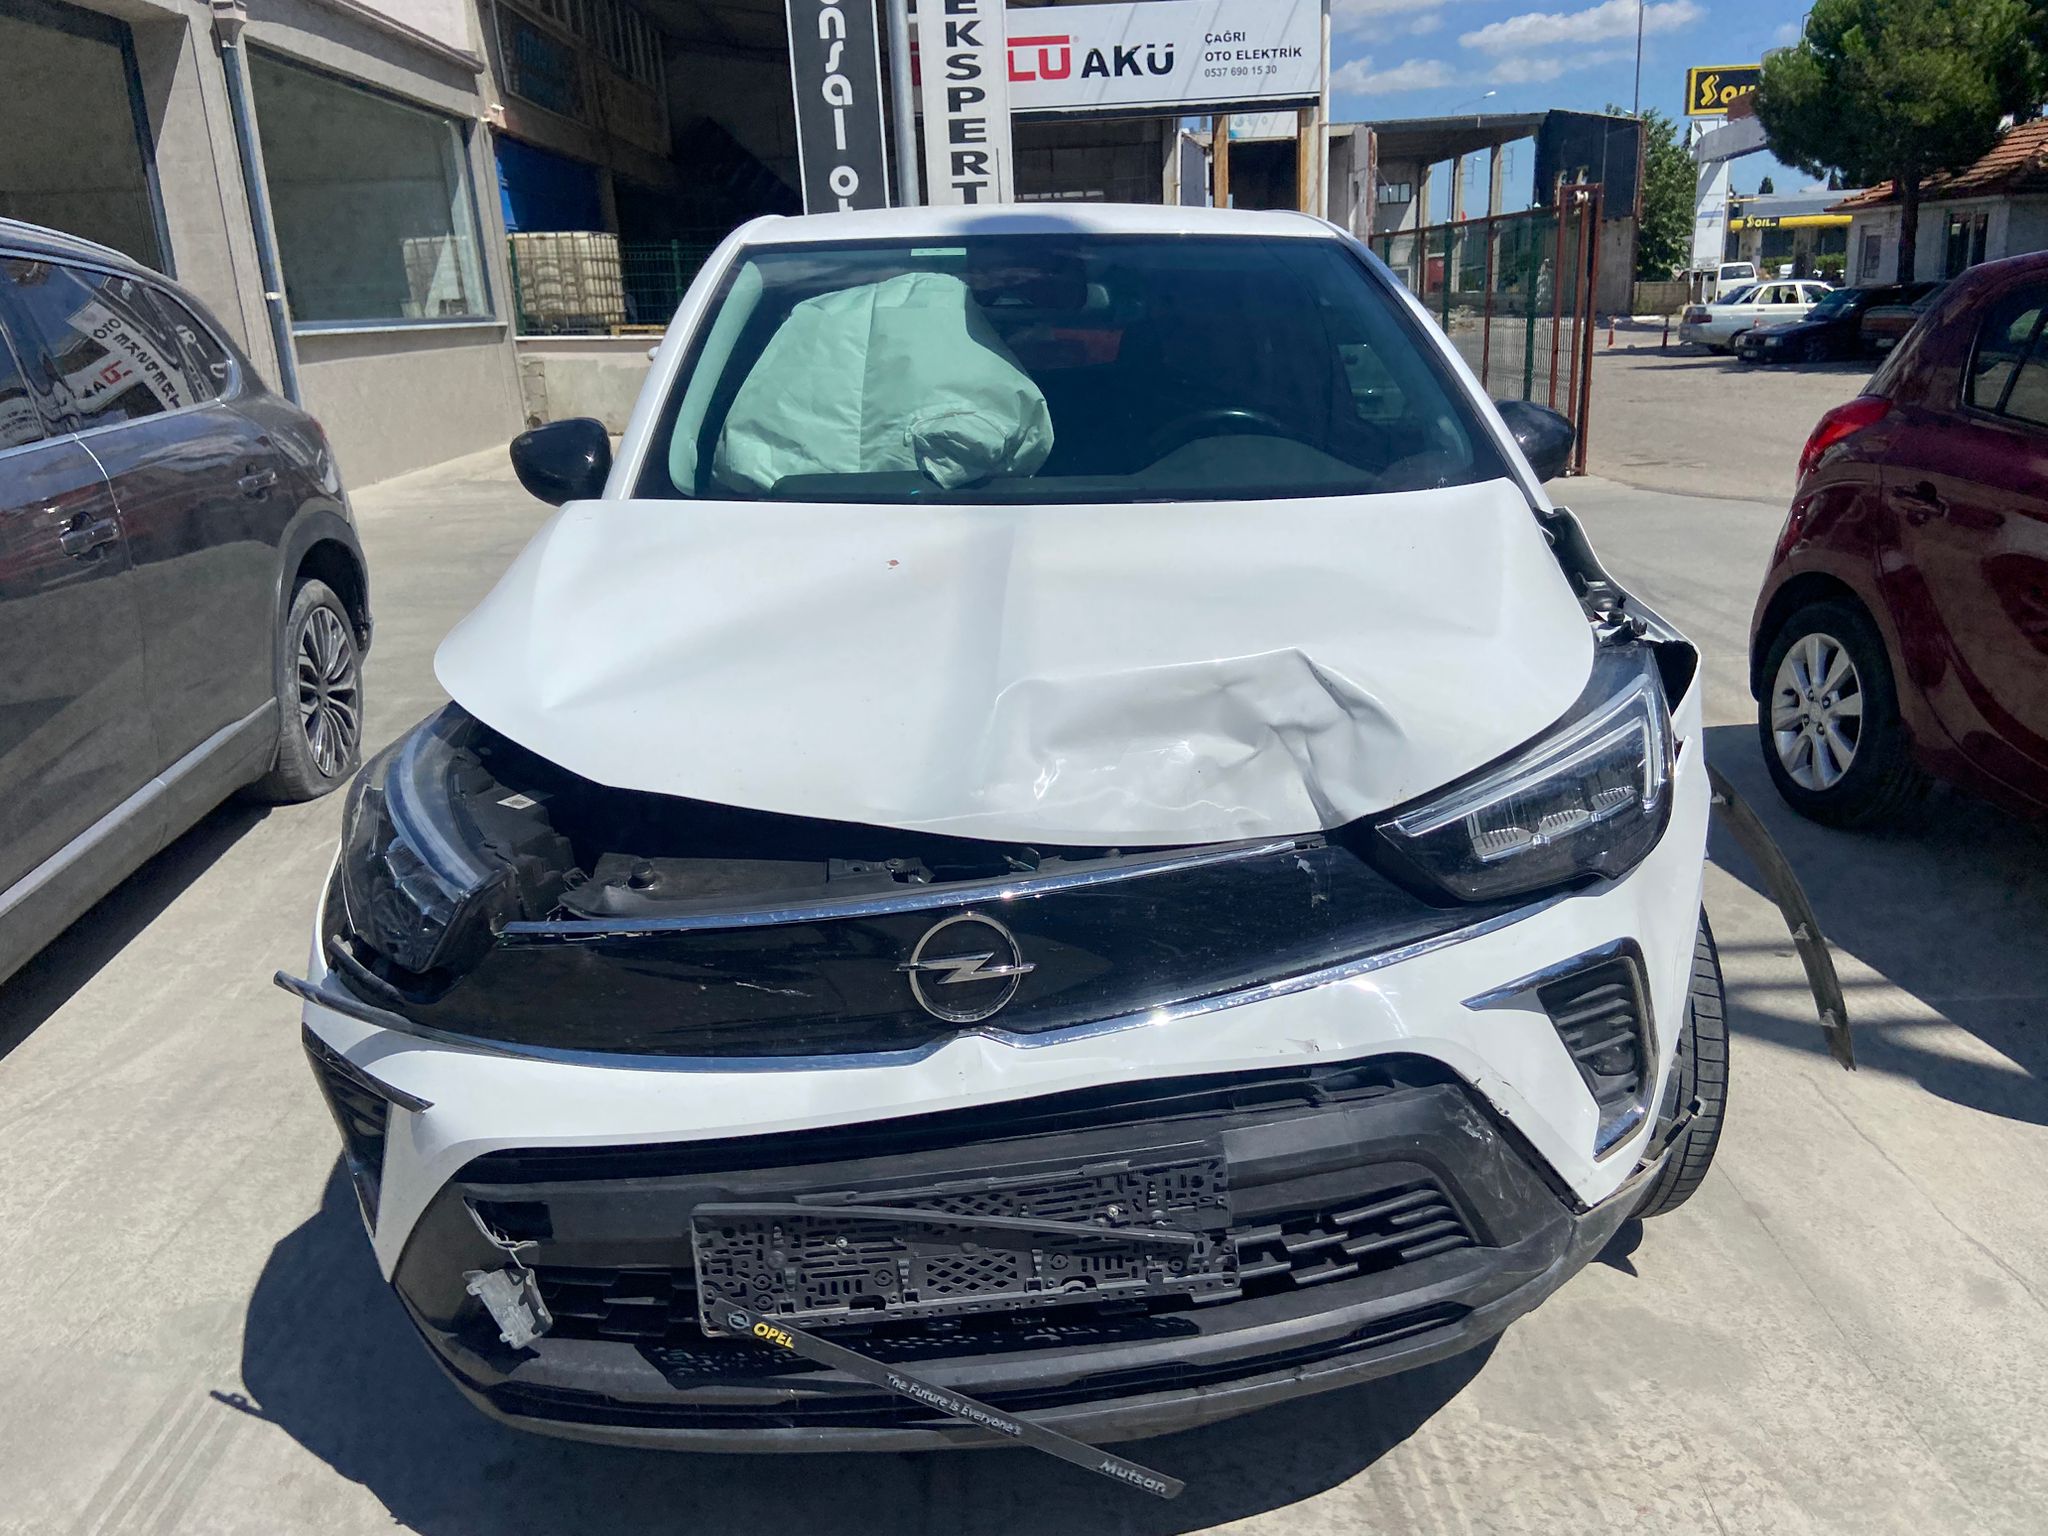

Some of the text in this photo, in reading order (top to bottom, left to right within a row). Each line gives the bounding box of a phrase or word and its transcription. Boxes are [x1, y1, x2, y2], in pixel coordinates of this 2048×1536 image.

[1204, 30, 1246, 46] ÇAĞRI
[1081, 43, 1174, 79] AKÜ
[1204, 45, 1302, 62] OTO ELEKTRİK
[818, 0, 853, 150] nsal
[1204, 64, 1277, 78] 0537 690 15 30
[753, 1322, 794, 1349] OPEL
[887, 1372, 906, 1390] The
[909, 1383, 948, 1407] Future
[949, 1399, 959, 1412] is
[1100, 1460, 1167, 1493] Mutsan
